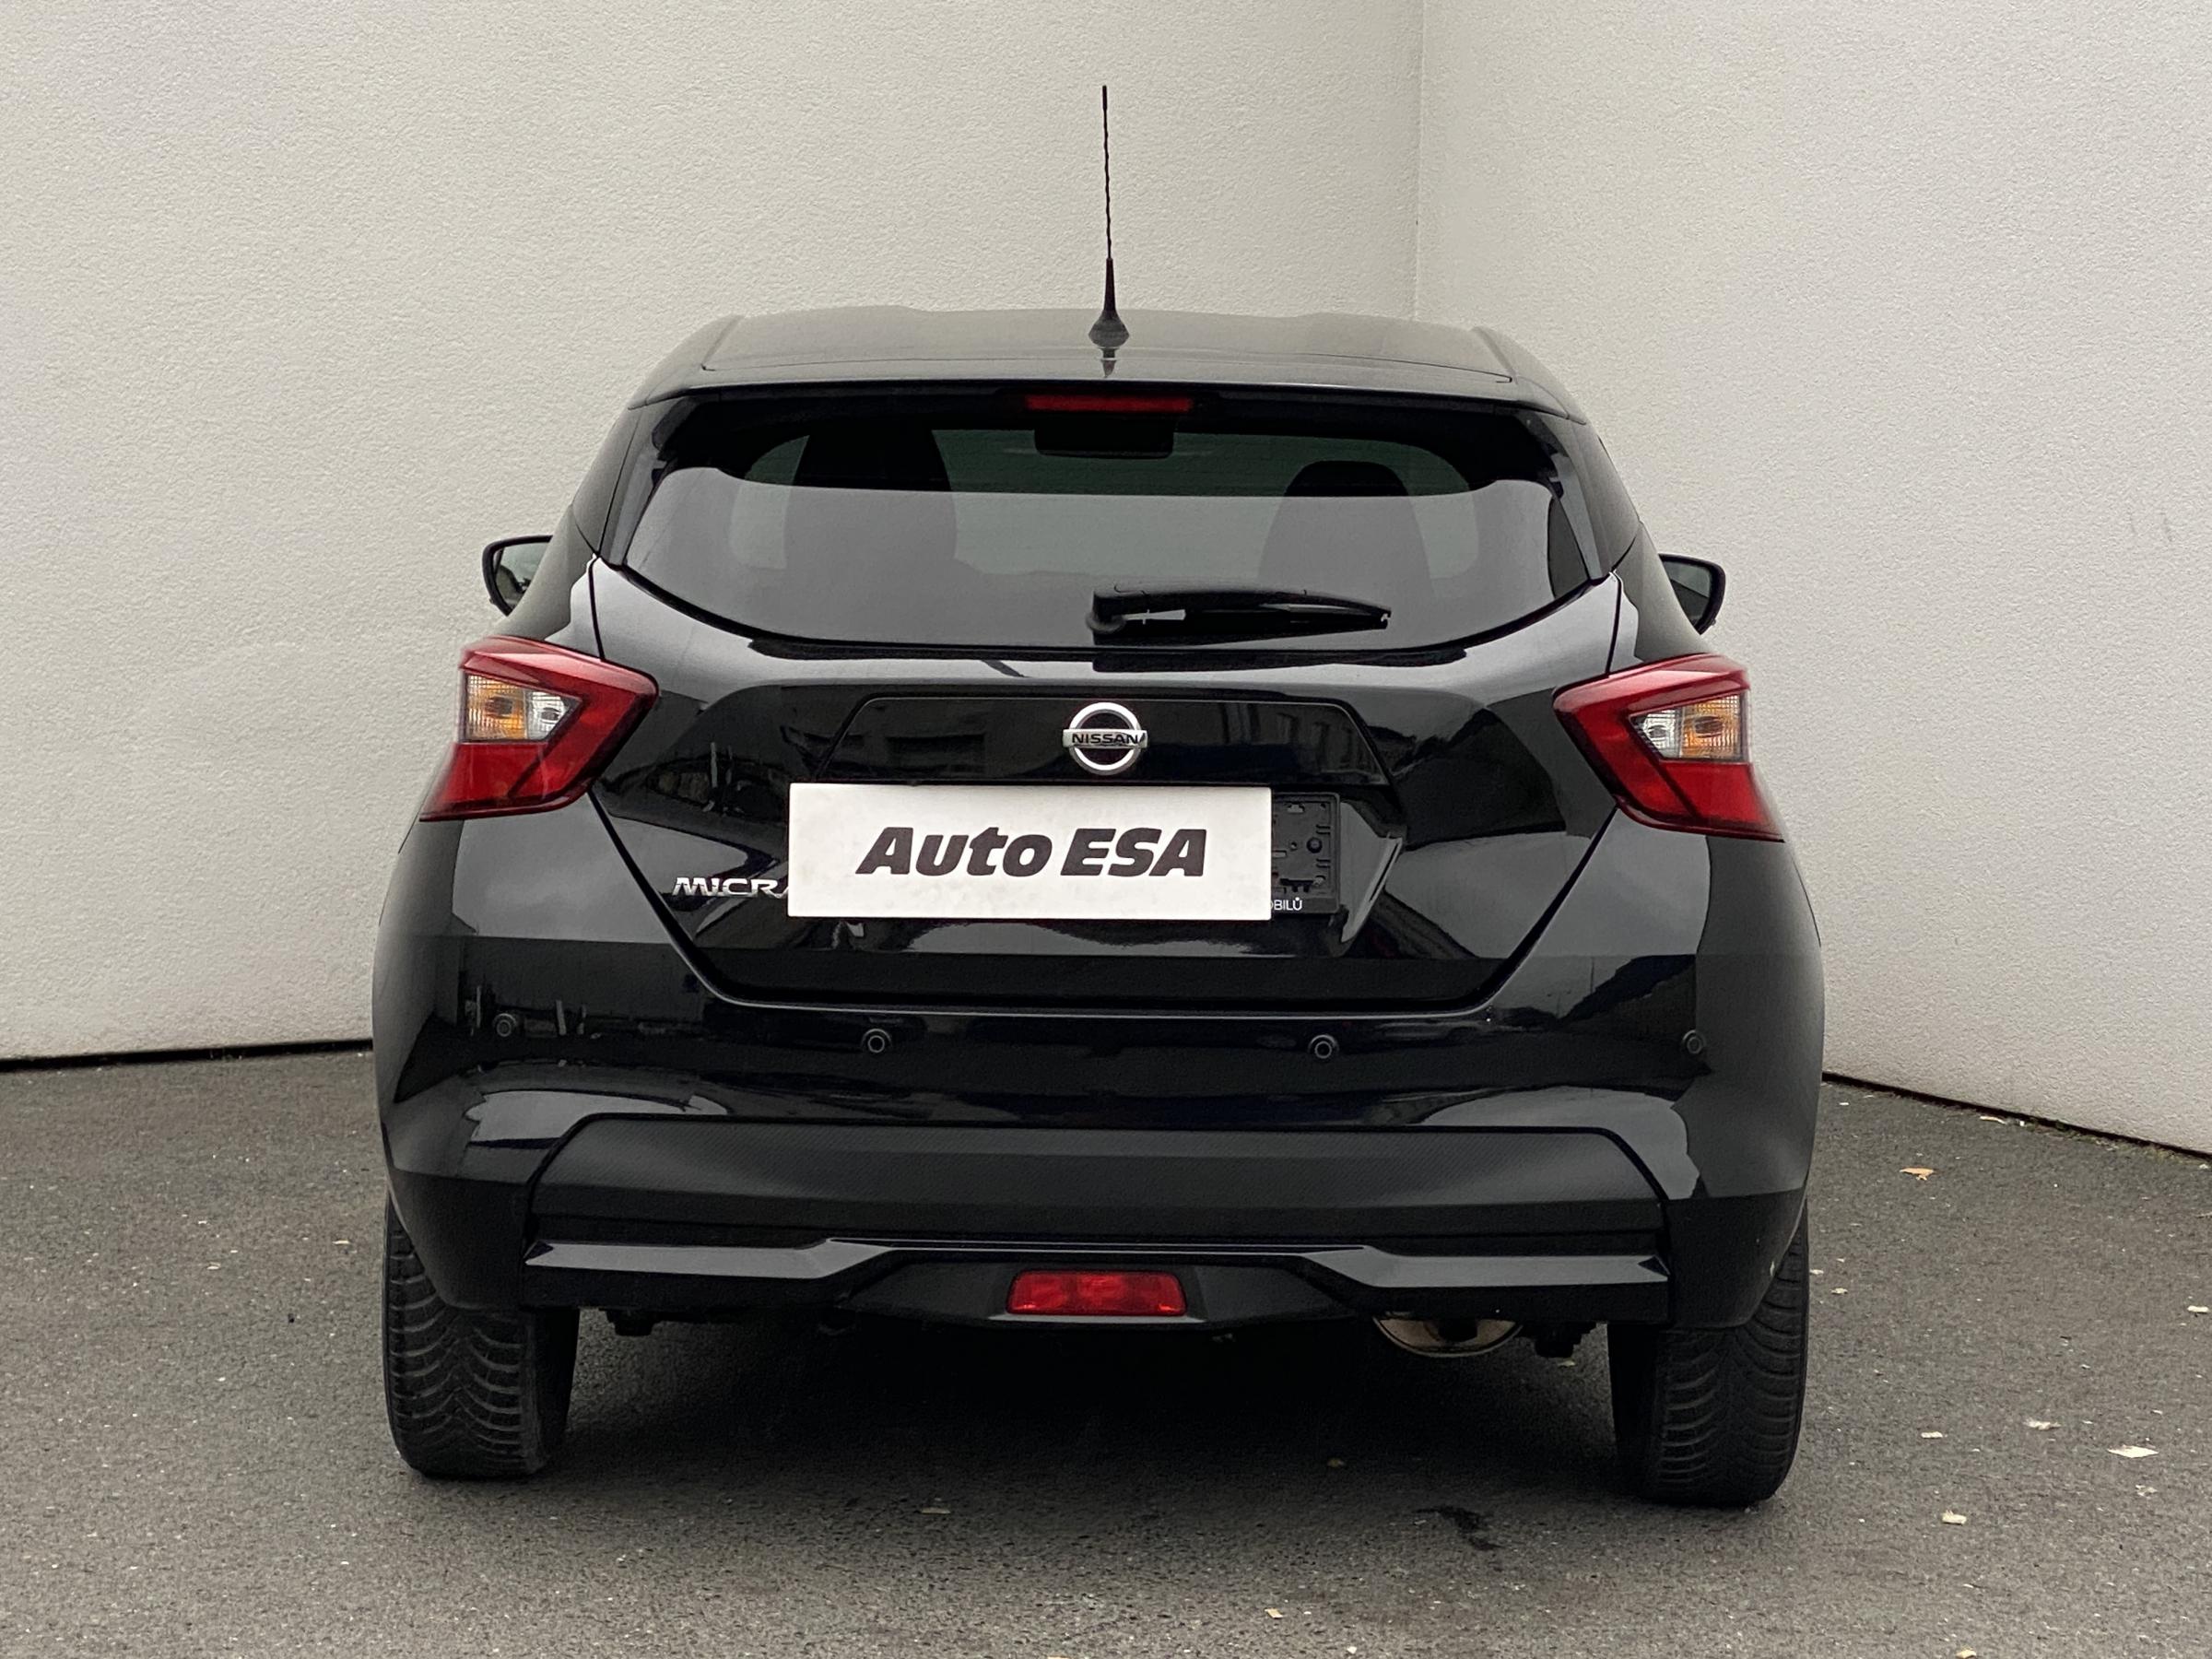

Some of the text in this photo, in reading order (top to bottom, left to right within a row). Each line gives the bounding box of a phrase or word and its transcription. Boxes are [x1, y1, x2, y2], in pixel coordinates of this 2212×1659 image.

[1072, 733, 1138, 744] NISSAN
[854, 827, 1207, 877] Auto ESA
[672, 877, 789, 899] MICR
[1271, 897, 1302, 911] BILŮ
